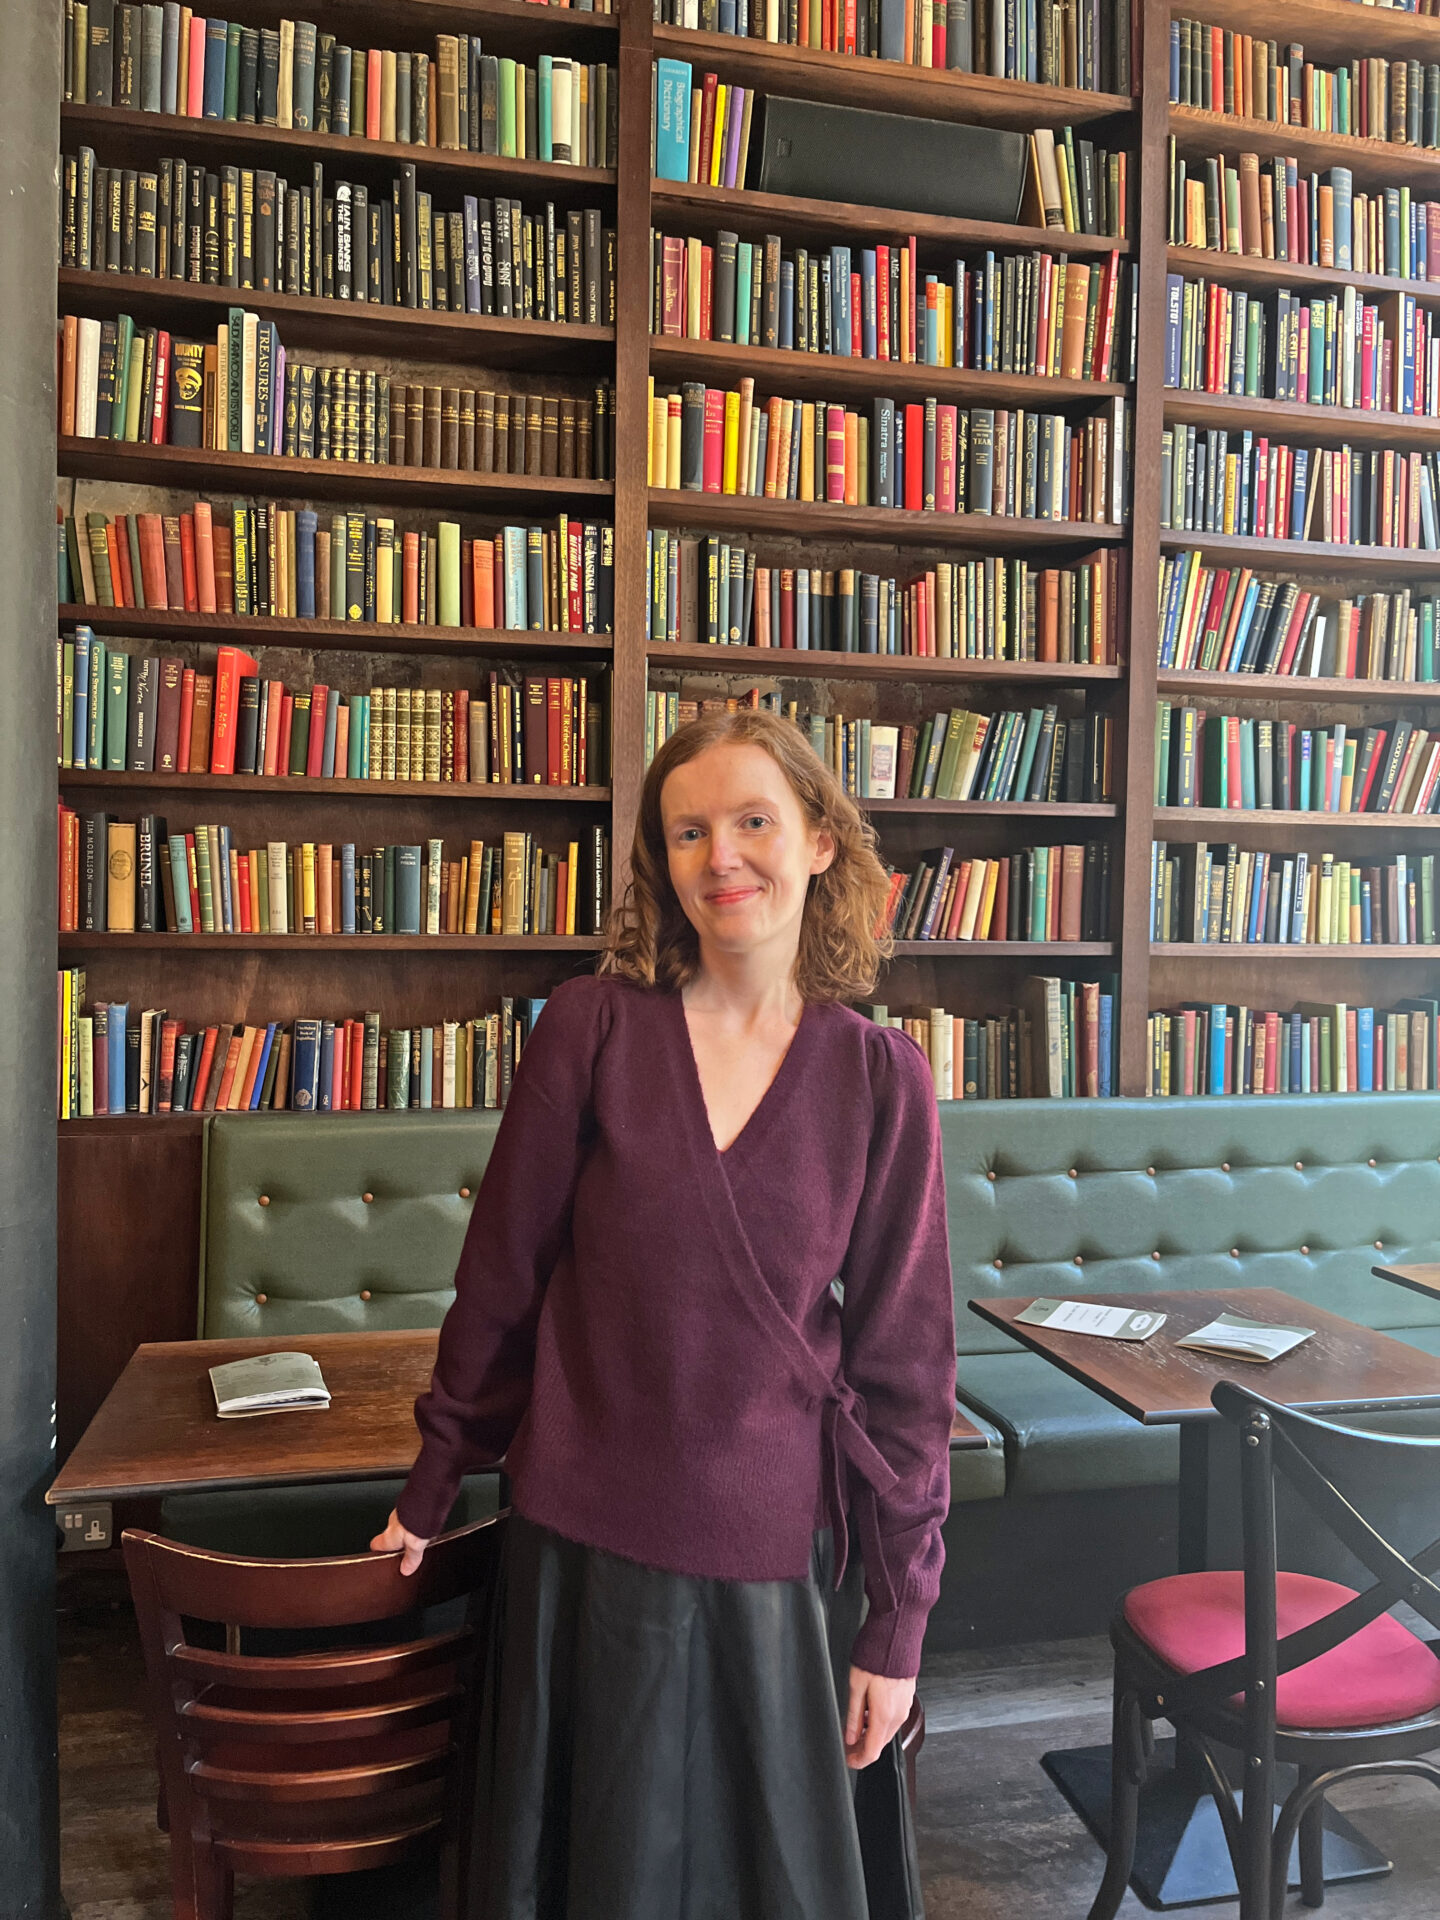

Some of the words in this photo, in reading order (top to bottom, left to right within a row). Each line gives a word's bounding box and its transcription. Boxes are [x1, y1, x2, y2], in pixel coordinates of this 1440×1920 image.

[662, 79, 673, 131] Dictionary
[673, 82, 686, 144] Biographical
[112, 181, 120, 206] SUSAN
[112, 206, 120, 233] SALLIS
[190, 225, 201, 259] Baldacci
[190, 260, 201, 283] David
[466, 249, 476, 281] BROWN
[503, 260, 512, 287] SAINT
[880, 304, 888, 335] SPORT
[1170, 286, 1180, 326] TOLSTOY
[231, 315, 240, 338] SAUDI
[175, 343, 203, 358] MONTY
[231, 340, 240, 377] ARAMCO
[258, 327, 270, 401] TREASURES
[231, 379, 240, 398] AND
[231, 399, 240, 408] ITS
[231, 409, 240, 442] WORLD
[880, 408, 891, 448] Sinatra
[973, 437, 992, 446] YEAR
[1025, 451, 1034, 479] CALLING
[235, 510, 247, 537] UNUSUAL
[569, 572, 578, 592] PARK
[585, 549, 598, 592] ANASTASIA
[86, 820, 94, 834] JIM
[86, 836, 94, 880] MORRISON
[140, 833, 152, 888] BRUNEL
[1227, 860, 1235, 891] PIRATES
